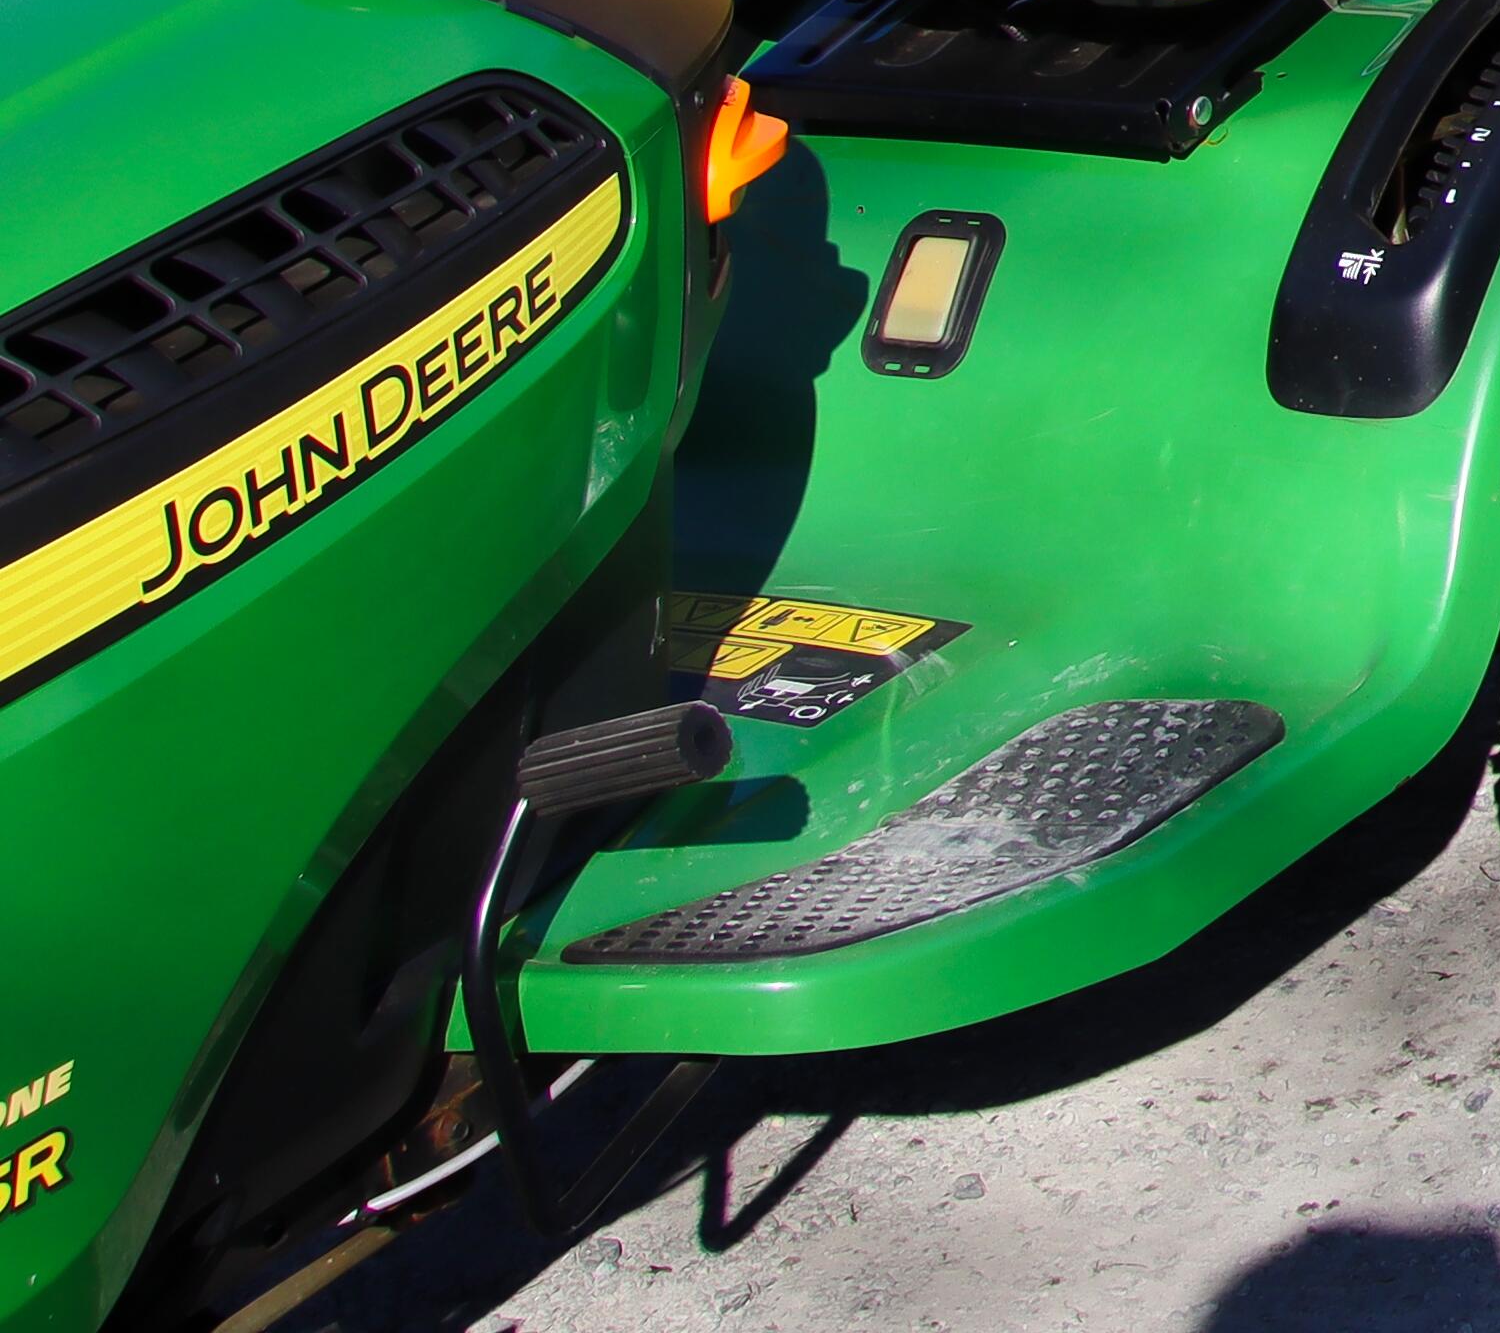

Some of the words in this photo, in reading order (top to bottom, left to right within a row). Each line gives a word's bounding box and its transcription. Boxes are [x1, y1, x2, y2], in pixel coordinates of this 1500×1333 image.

[1471, 127, 1491, 142] 2
[1446, 188, 1457, 204] 1
[140, 411, 351, 596] JOHN
[360, 251, 559, 455] DEERE
[0, 1059, 75, 1128] NE
